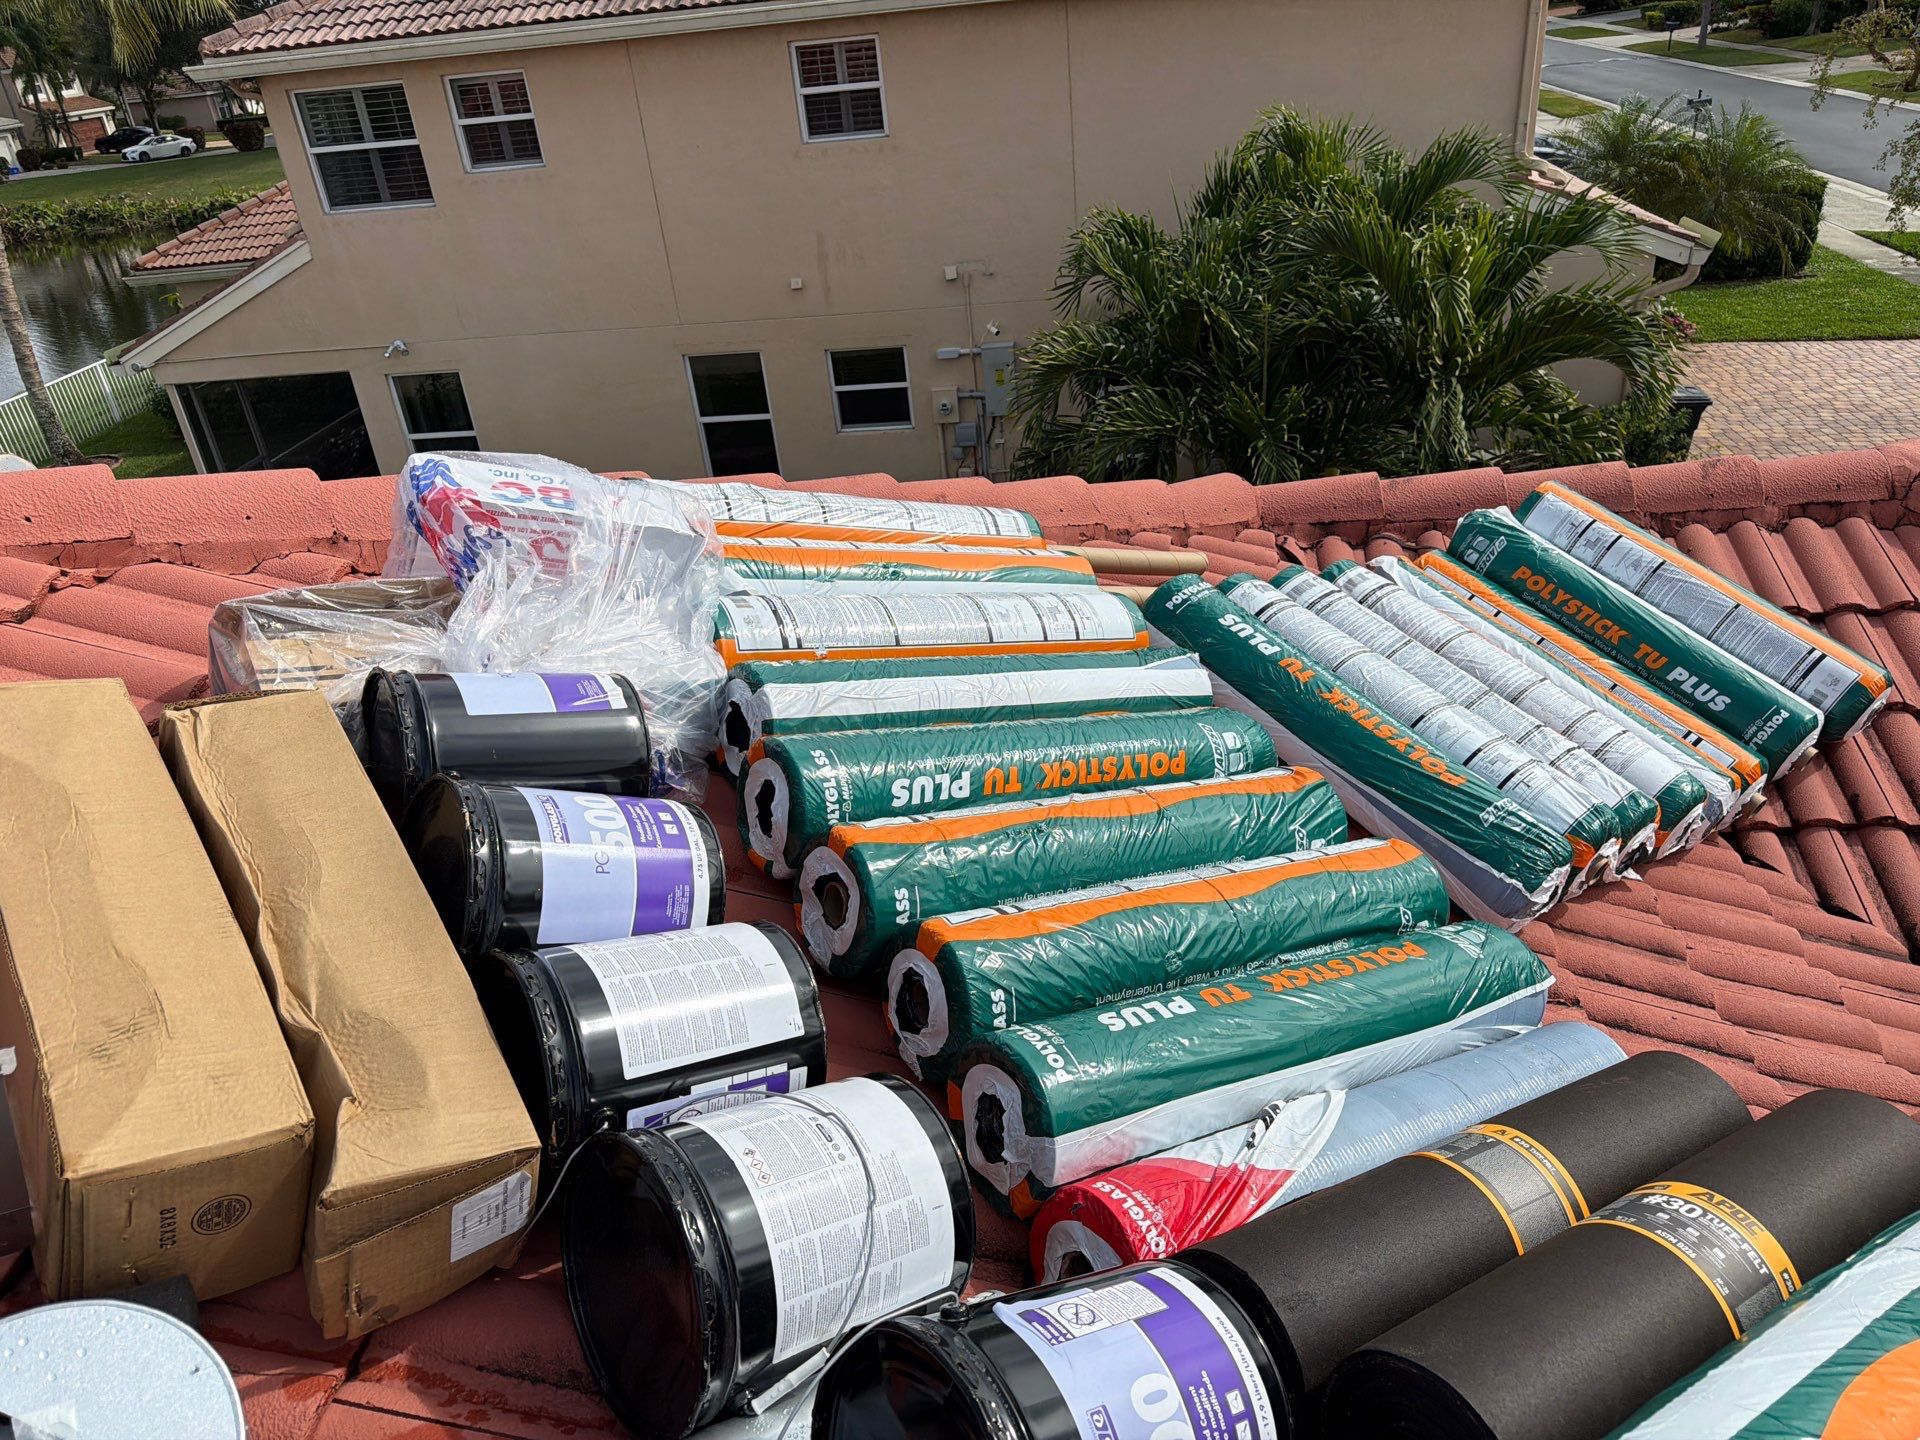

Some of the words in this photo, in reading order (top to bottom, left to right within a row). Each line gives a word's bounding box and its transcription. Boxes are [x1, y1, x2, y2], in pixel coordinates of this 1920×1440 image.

[490, 481, 575, 511] BC
[1218, 613, 1282, 655] PLUS
[1510, 566, 1633, 645] POLYSTICK
[1634, 643, 1669, 669] TU
[1665, 666, 1732, 712] PLUS
[1521, 590, 1562, 620] Self-Adhered
[1560, 616, 1595, 642] Reinforced
[1593, 637, 1612, 653] Wind
[1616, 653, 1637, 669] Water
[1279, 657, 1316, 684] TU
[1317, 687, 1469, 786] POLYSTICK
[1750, 709, 1790, 750] POLYGL
[891, 771, 970, 808] PLUS
[984, 766, 1024, 796] TU
[1041, 749, 1187, 790] POLYSTICK
[543, 802, 565, 844] POLYGLASS
[1261, 940, 1430, 991] POLYSTICK
[1098, 997, 1197, 1031] PLUS
[1199, 984, 1253, 1008] TU
[158, 1206, 178, 1250] 8X8X32
[1091, 1180, 1166, 1258] OLYGLASS
[1641, 1194, 1703, 1218] #30
[1706, 1213, 1769, 1275] TUFF-FELT
[1654, 1229, 1677, 1244] ASTM
[1187, 1385, 1209, 1427] Cement
[1197, 1387, 1218, 1429] modifié
[1199, 1369, 1228, 1431] modificado
[1258, 1404, 1270, 1427] 17.9
